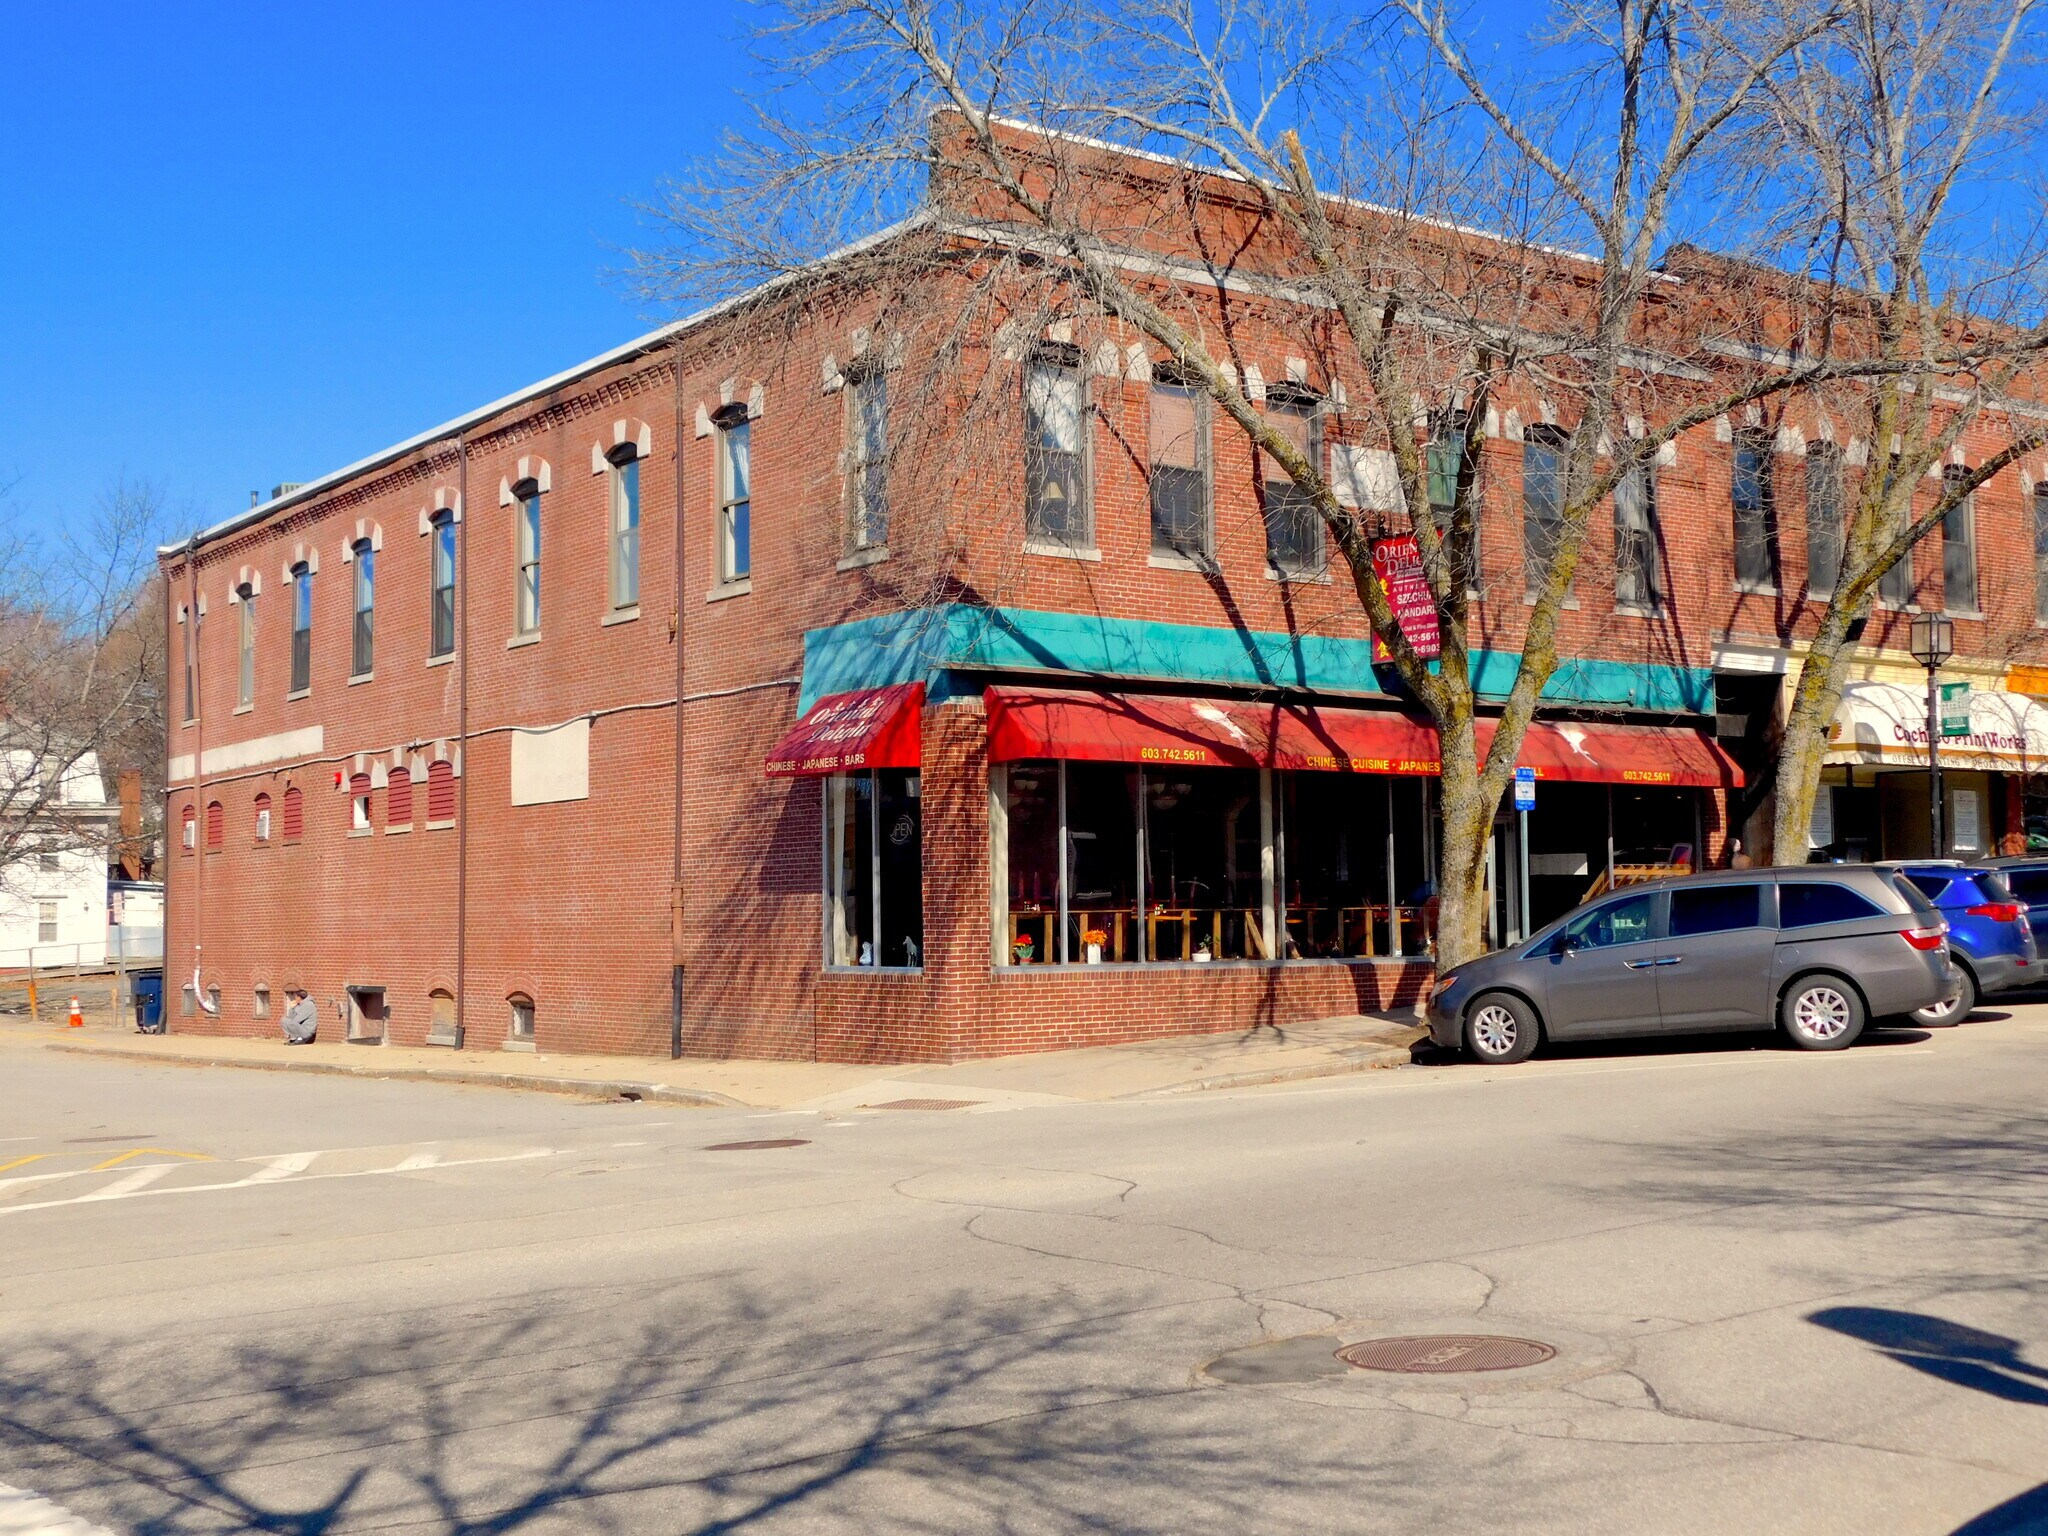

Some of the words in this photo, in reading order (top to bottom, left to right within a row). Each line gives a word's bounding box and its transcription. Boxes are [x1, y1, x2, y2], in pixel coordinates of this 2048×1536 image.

[1375, 543, 1418, 562] ORIEN
[1392, 582, 1426, 593] AUTHEN
[1396, 590, 1432, 605] SZECHU
[1405, 631, 1440, 643] 42-5611
[809, 700, 885, 725] Oriental
[806, 720, 874, 744] Delight
[766, 761, 796, 772] CHINESE
[802, 756, 839, 770] JAPANESE
[845, 753, 865, 766] BARS
[1141, 748, 1206, 761] 603.742.5611
[1306, 756, 1349, 768] CHINESE
[1351, 758, 1390, 770] CUISINE
[1398, 760, 1440, 773] JAPANES
[1623, 770, 1671, 782] 603.742.5611
